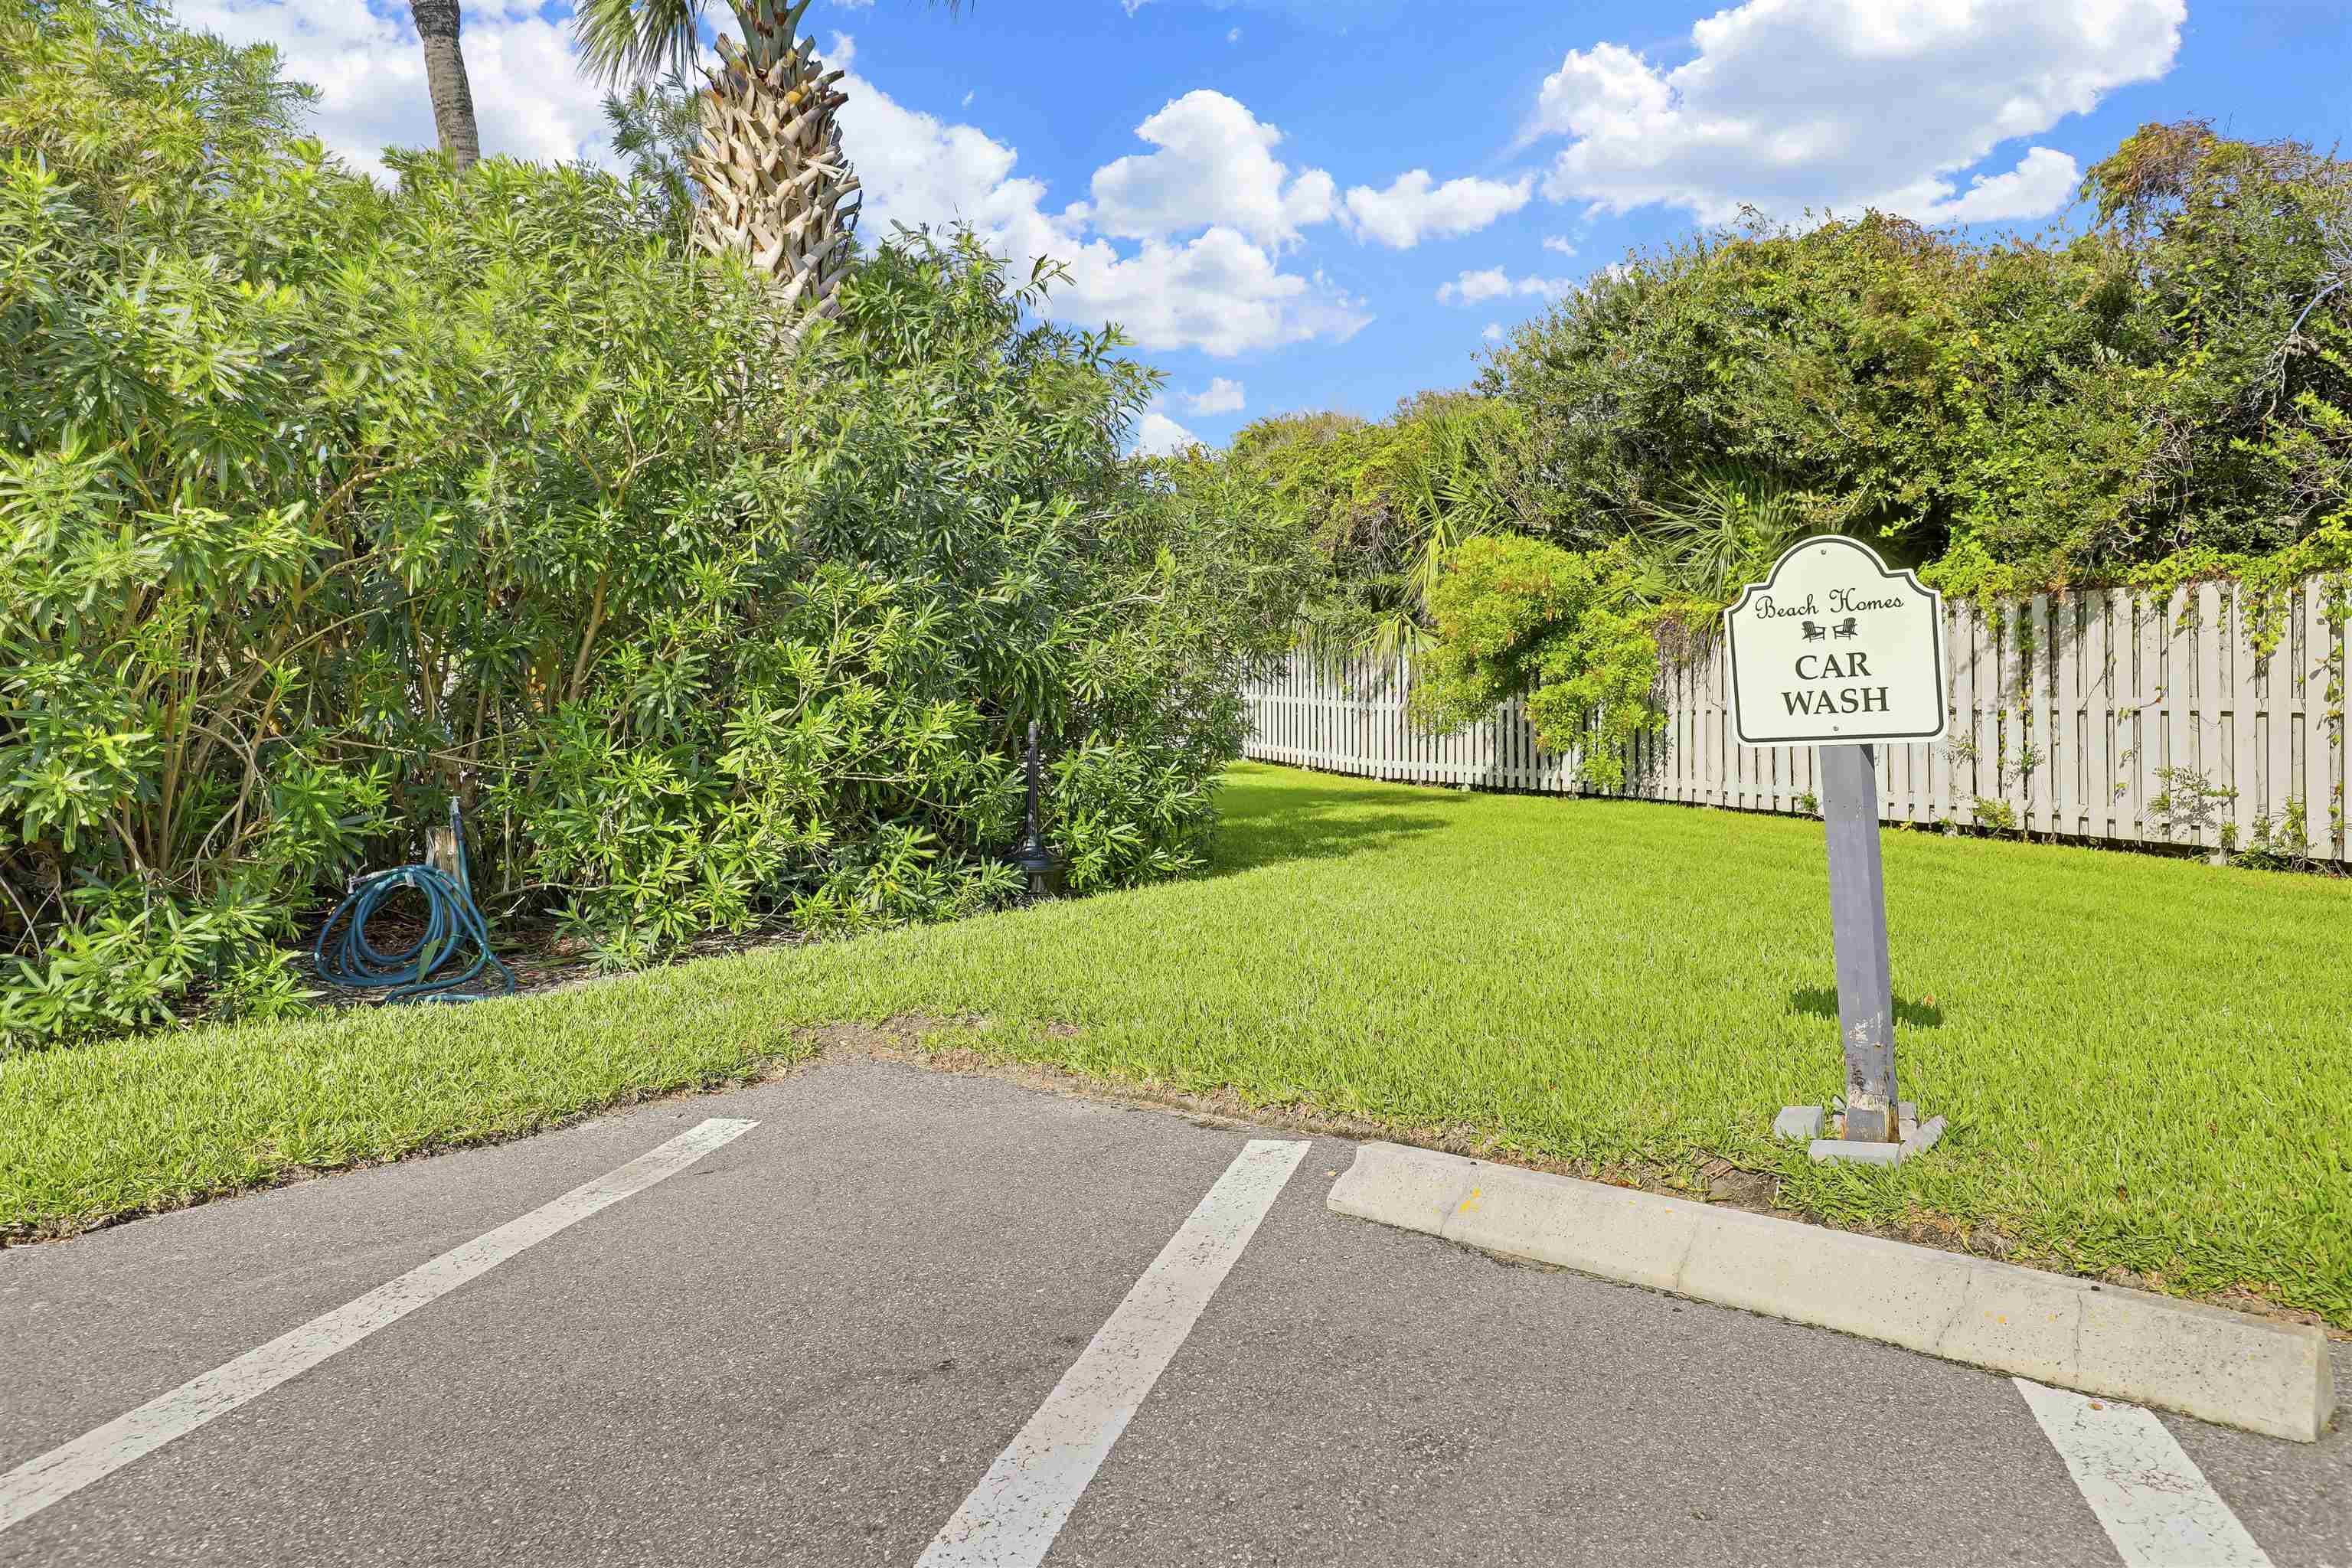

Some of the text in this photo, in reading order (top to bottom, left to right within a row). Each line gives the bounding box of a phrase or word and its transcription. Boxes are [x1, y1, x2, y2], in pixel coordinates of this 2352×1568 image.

[1755, 587, 1904, 619] Beach Homes
[1795, 652, 1872, 680] CAR
[1781, 686, 1890, 716] WASH
